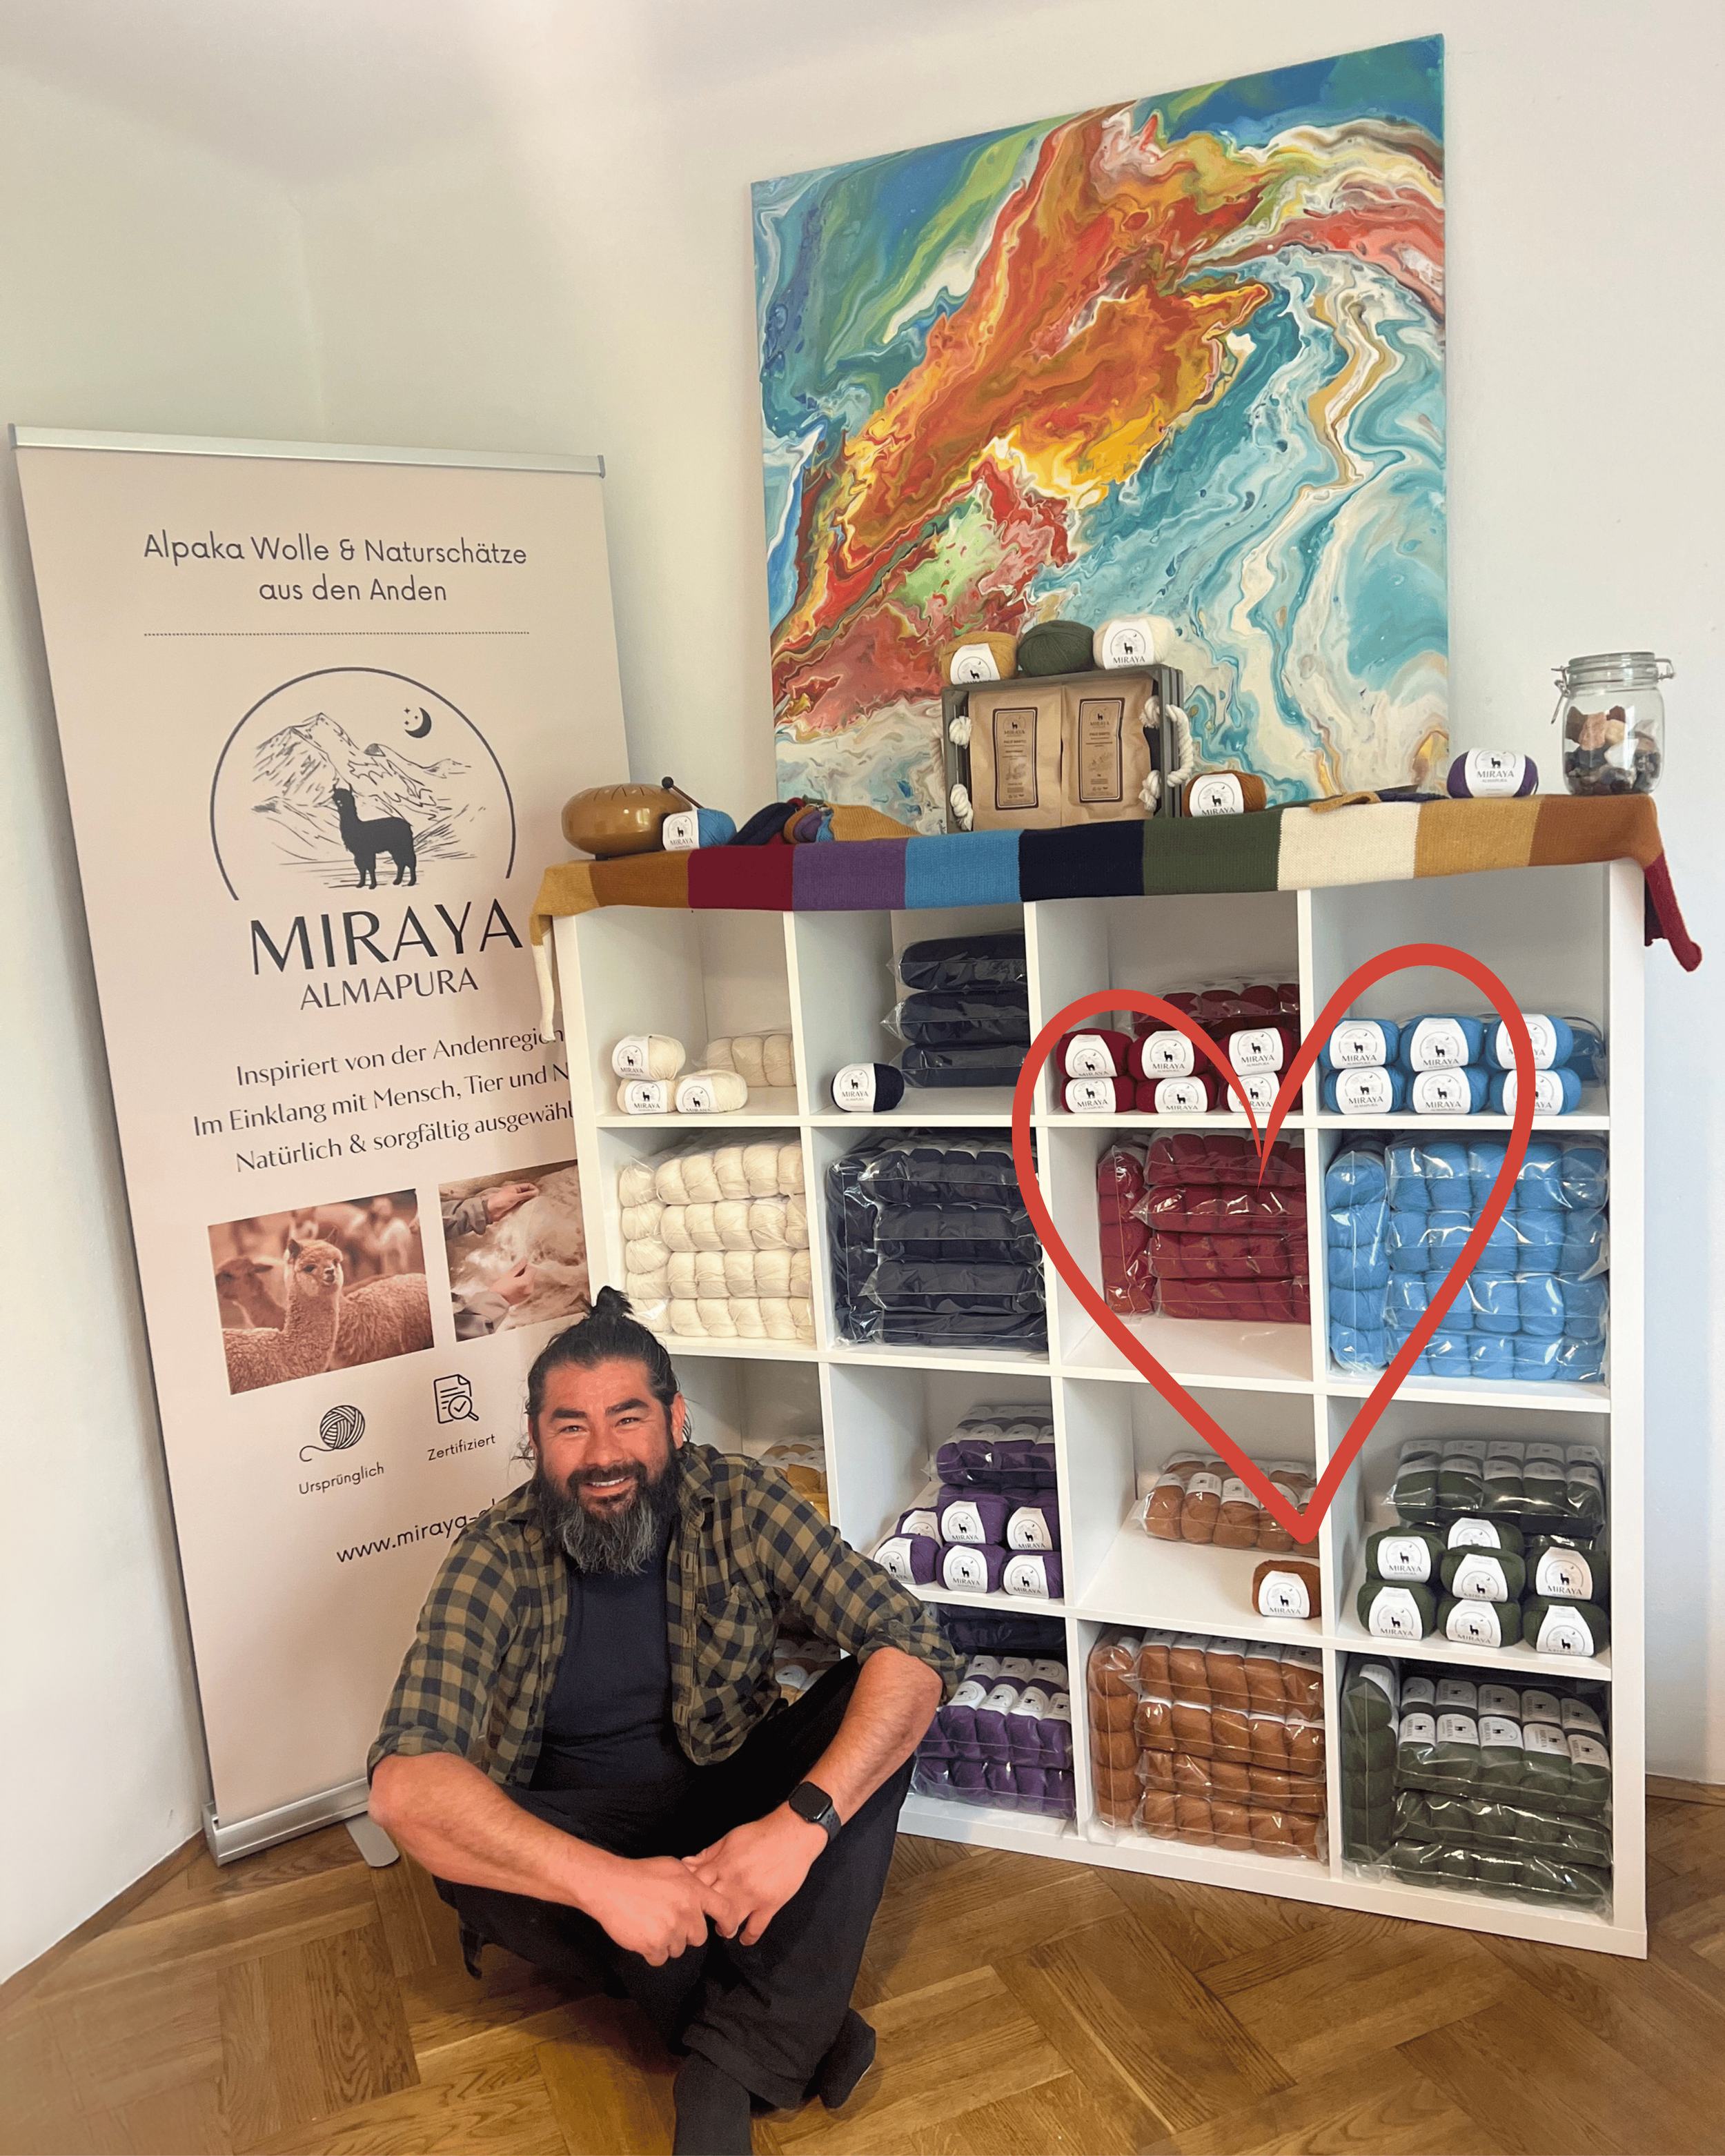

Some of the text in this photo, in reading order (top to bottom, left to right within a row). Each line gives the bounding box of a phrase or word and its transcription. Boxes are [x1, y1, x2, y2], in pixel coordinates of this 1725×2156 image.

[144, 529, 527, 566] Alpaka Wolle & Naturschätze
[259, 573, 446, 601] aus den Anden
[1113, 655, 1145, 664] MIRAYA
[1477, 770, 1515, 778] MIRAYA
[1201, 807, 1235, 815] MIRAYA
[670, 838, 693, 846] MIRAYA
[250, 898, 524, 975] MIRAYA
[300, 967, 479, 1011] ALMAPURA
[1508, 1048, 1546, 1056] MYA
[1241, 1054, 1275, 1063] MIRAYA
[1342, 1054, 1377, 1062] MIRAYA
[1423, 1058, 1459, 1067] MIRAYA
[237, 1056, 339, 1087] Inspiriert
[345, 1051, 385, 1071] von
[391, 1044, 428, 1065] der
[193, 1114, 224, 1136] Im
[230, 1100, 327, 1131] Einklang
[333, 1093, 368, 1116] mit
[373, 1079, 462, 1109] Mensch,
[464, 1074, 504, 1096] Tier
[509, 1065, 547, 1088] und
[1077, 1099, 1108, 1107] MIRAYA
[1348, 1096, 1383, 1105] MIRAYA
[236, 1138, 342, 1172] Natürlich
[349, 1134, 367, 1154] &
[373, 1119, 470, 1151] sorgfältig
[427, 1434, 496, 1461] Zertifiziert
[298, 1461, 384, 1495] Ursprünglich
[336, 1498, 495, 1563] www.miraya-
[1547, 1585, 1583, 1596] MIRAYA
[1381, 1628, 1414, 1636] MIRAYA
[1457, 1634, 1491, 1644] MIRAYA
